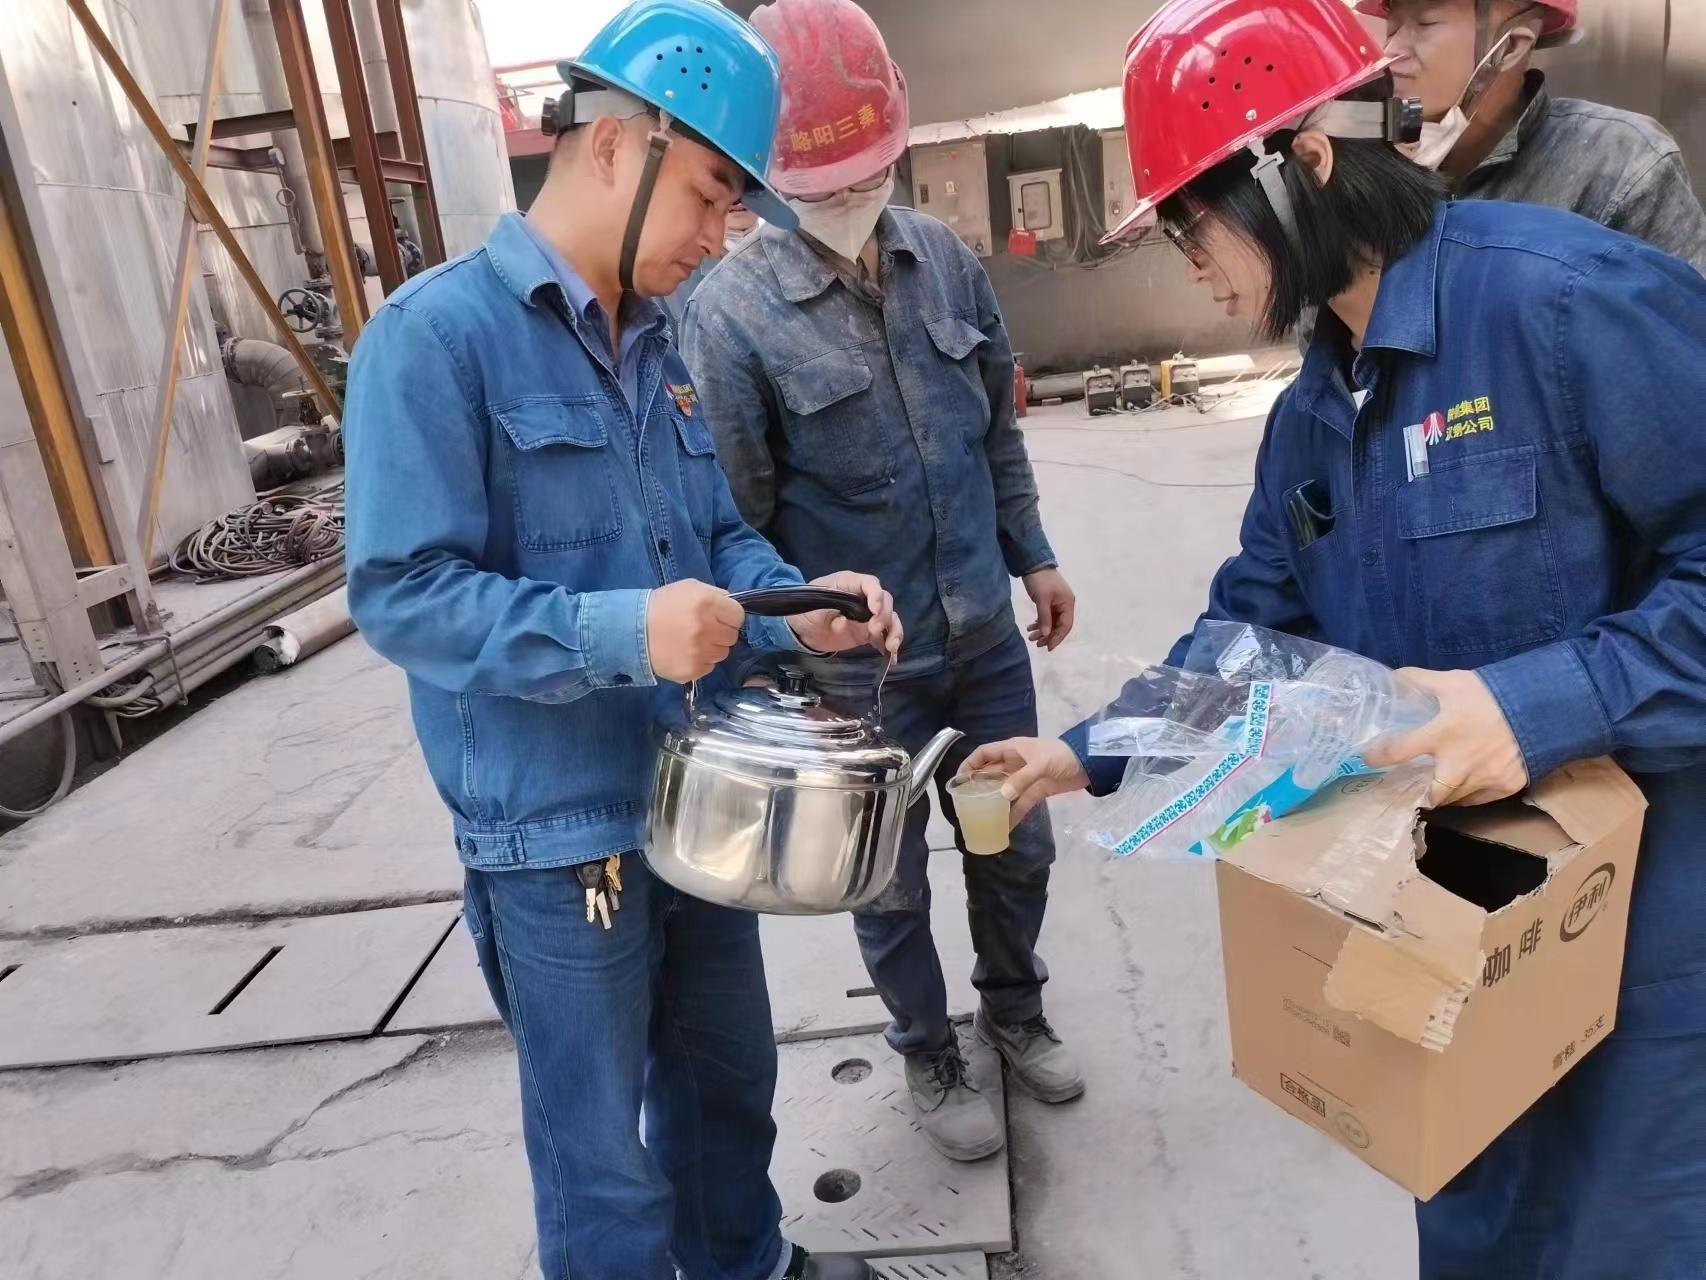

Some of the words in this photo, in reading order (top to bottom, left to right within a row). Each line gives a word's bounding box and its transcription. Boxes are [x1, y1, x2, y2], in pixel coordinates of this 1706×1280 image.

[790, 103, 876, 151] 略阳三秦
[1567, 875, 1607, 928] 伊利
[1482, 917, 1543, 988] 咖啡
